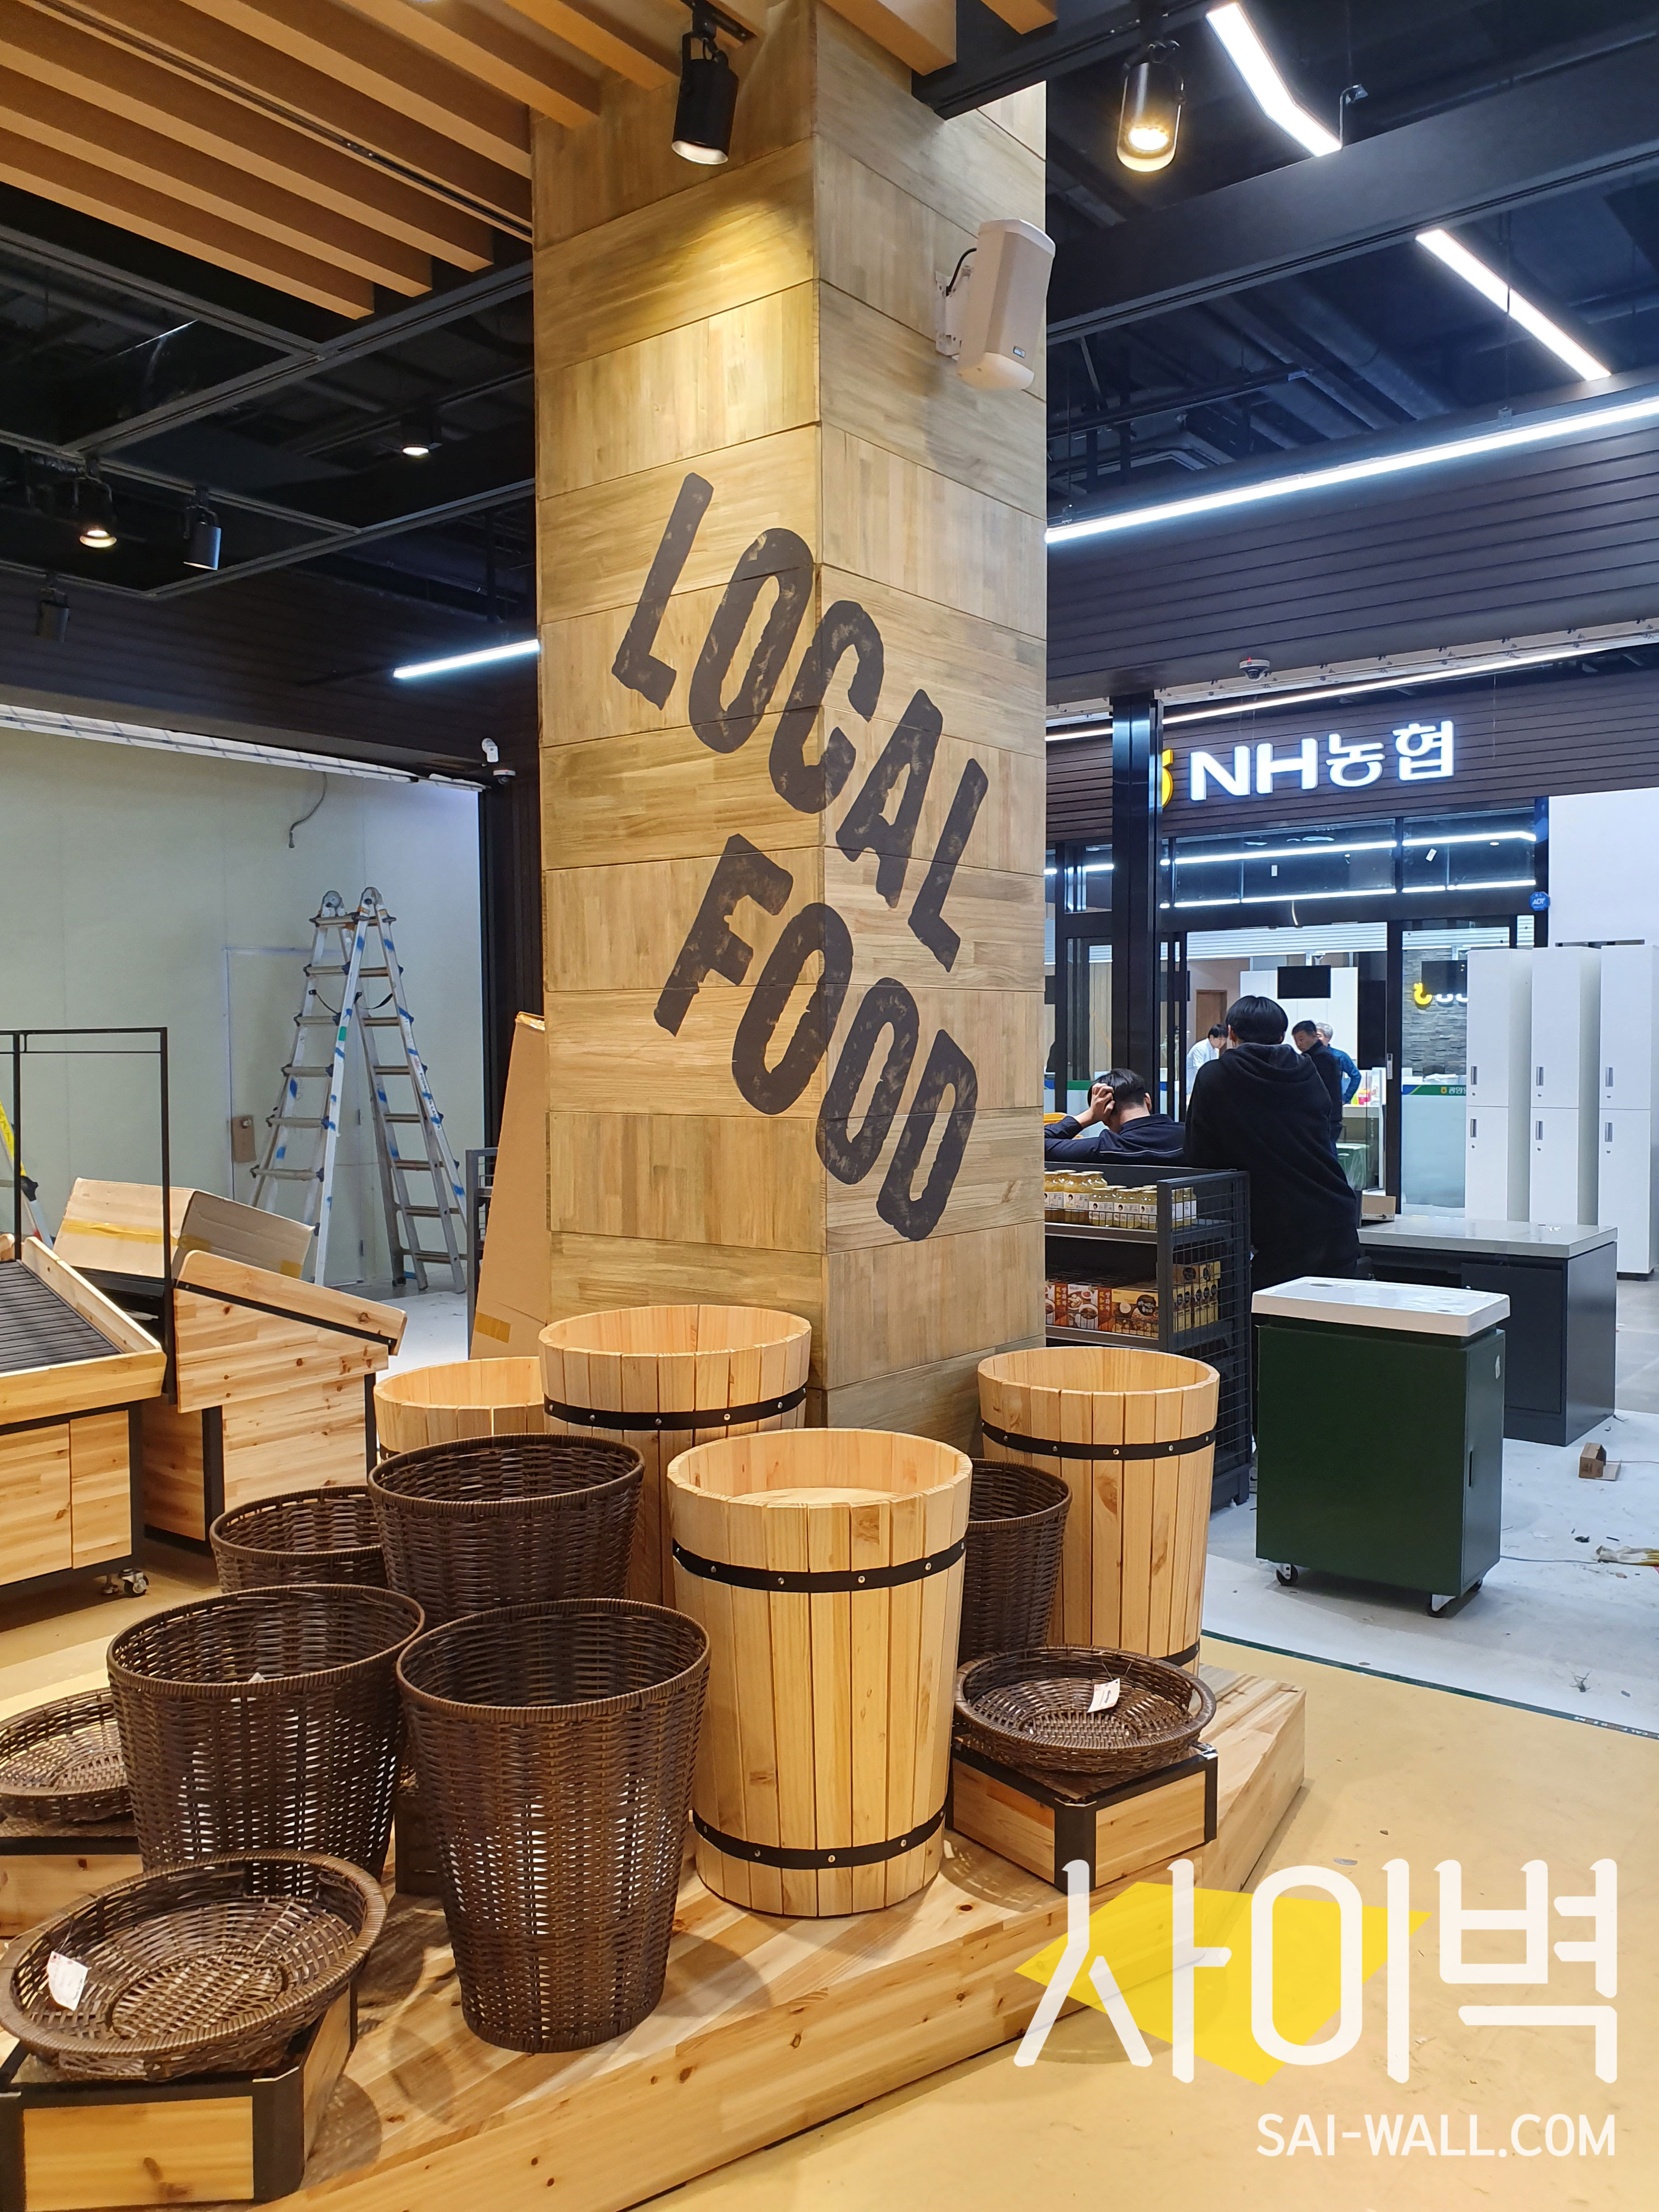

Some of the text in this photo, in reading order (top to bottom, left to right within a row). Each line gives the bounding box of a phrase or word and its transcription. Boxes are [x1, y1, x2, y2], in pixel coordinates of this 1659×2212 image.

[612, 472, 988, 973] LOCAL
[1190, 720, 1454, 801] NH농협
[654, 833, 978, 1242] FOOD
